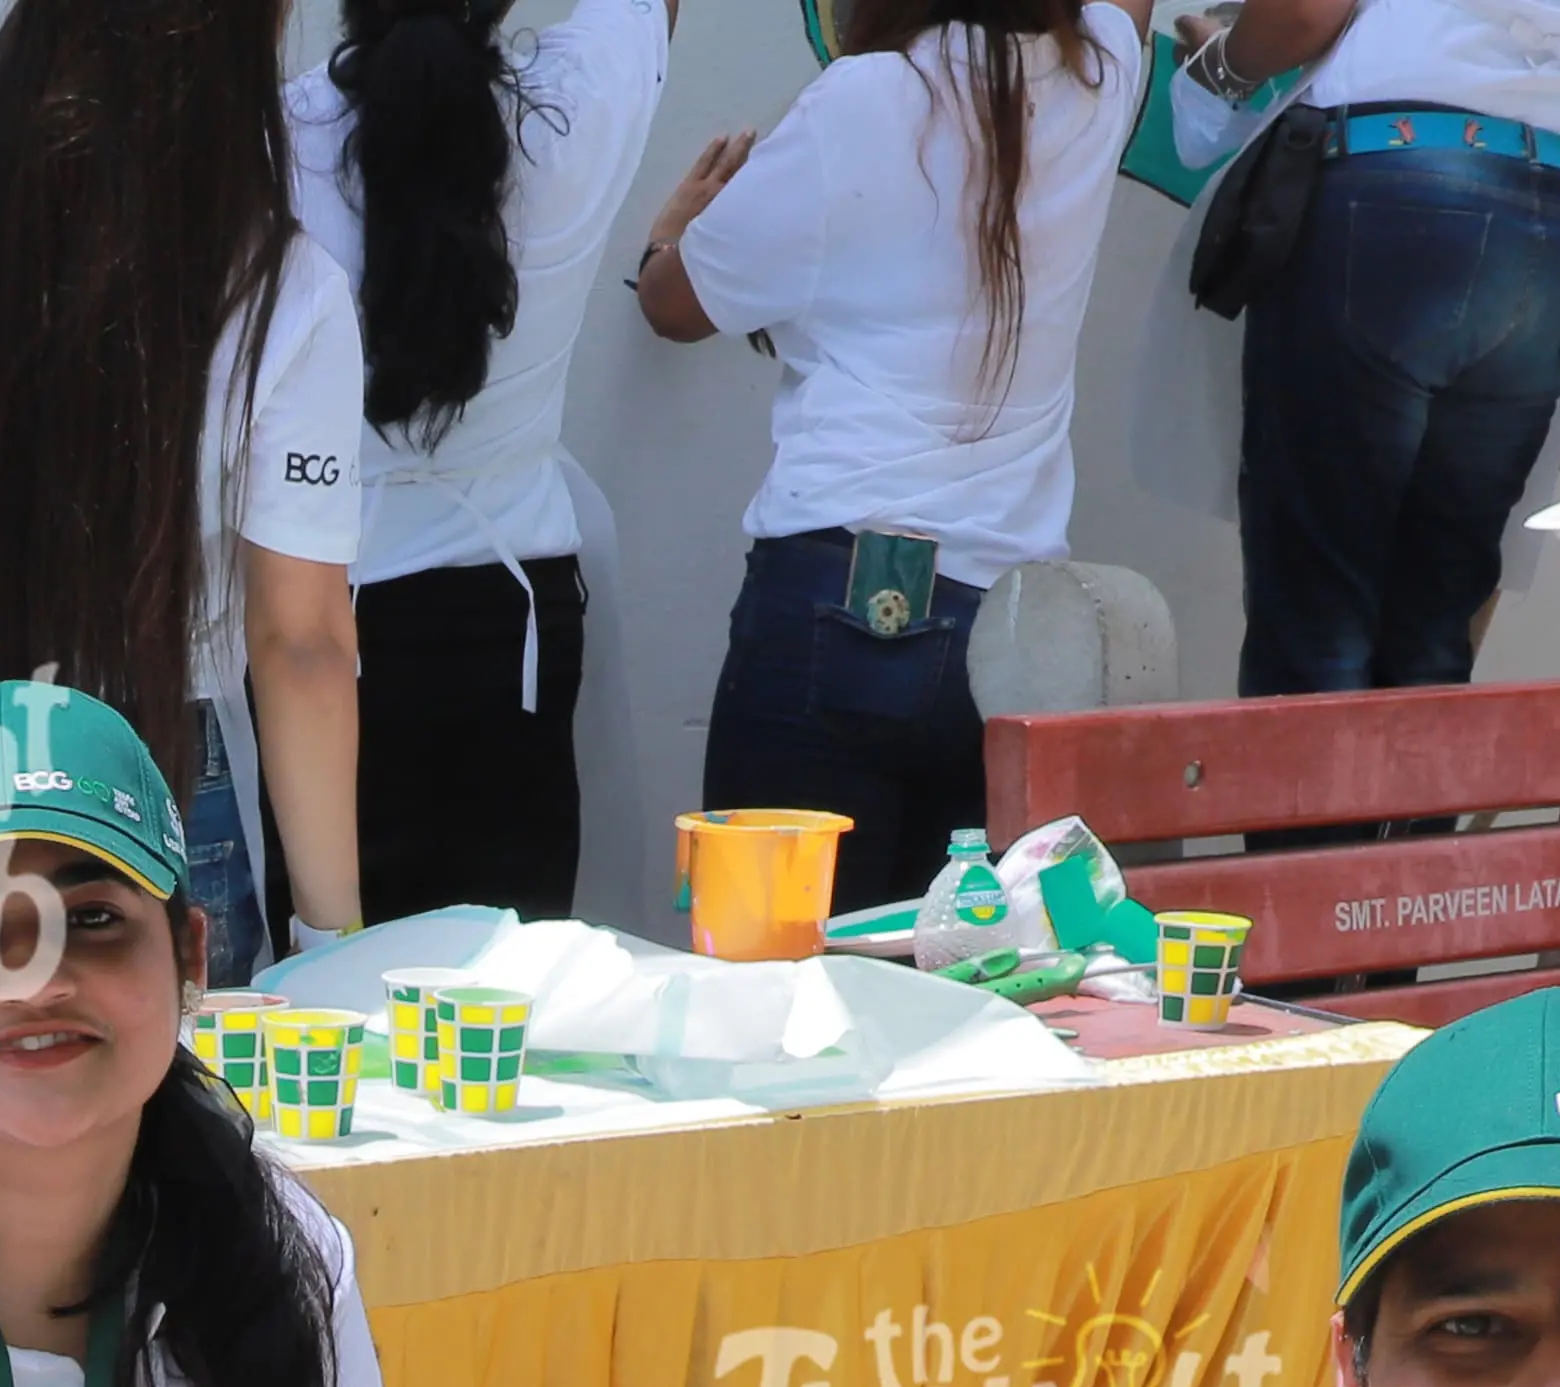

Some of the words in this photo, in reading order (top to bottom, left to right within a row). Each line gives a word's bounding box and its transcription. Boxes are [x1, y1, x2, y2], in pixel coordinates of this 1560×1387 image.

[285, 452, 340, 486] BCG
[13, 771, 72, 791] BCG
[1334, 898, 1389, 932] SMT.
[1398, 884, 1507, 926] PARVEEN
